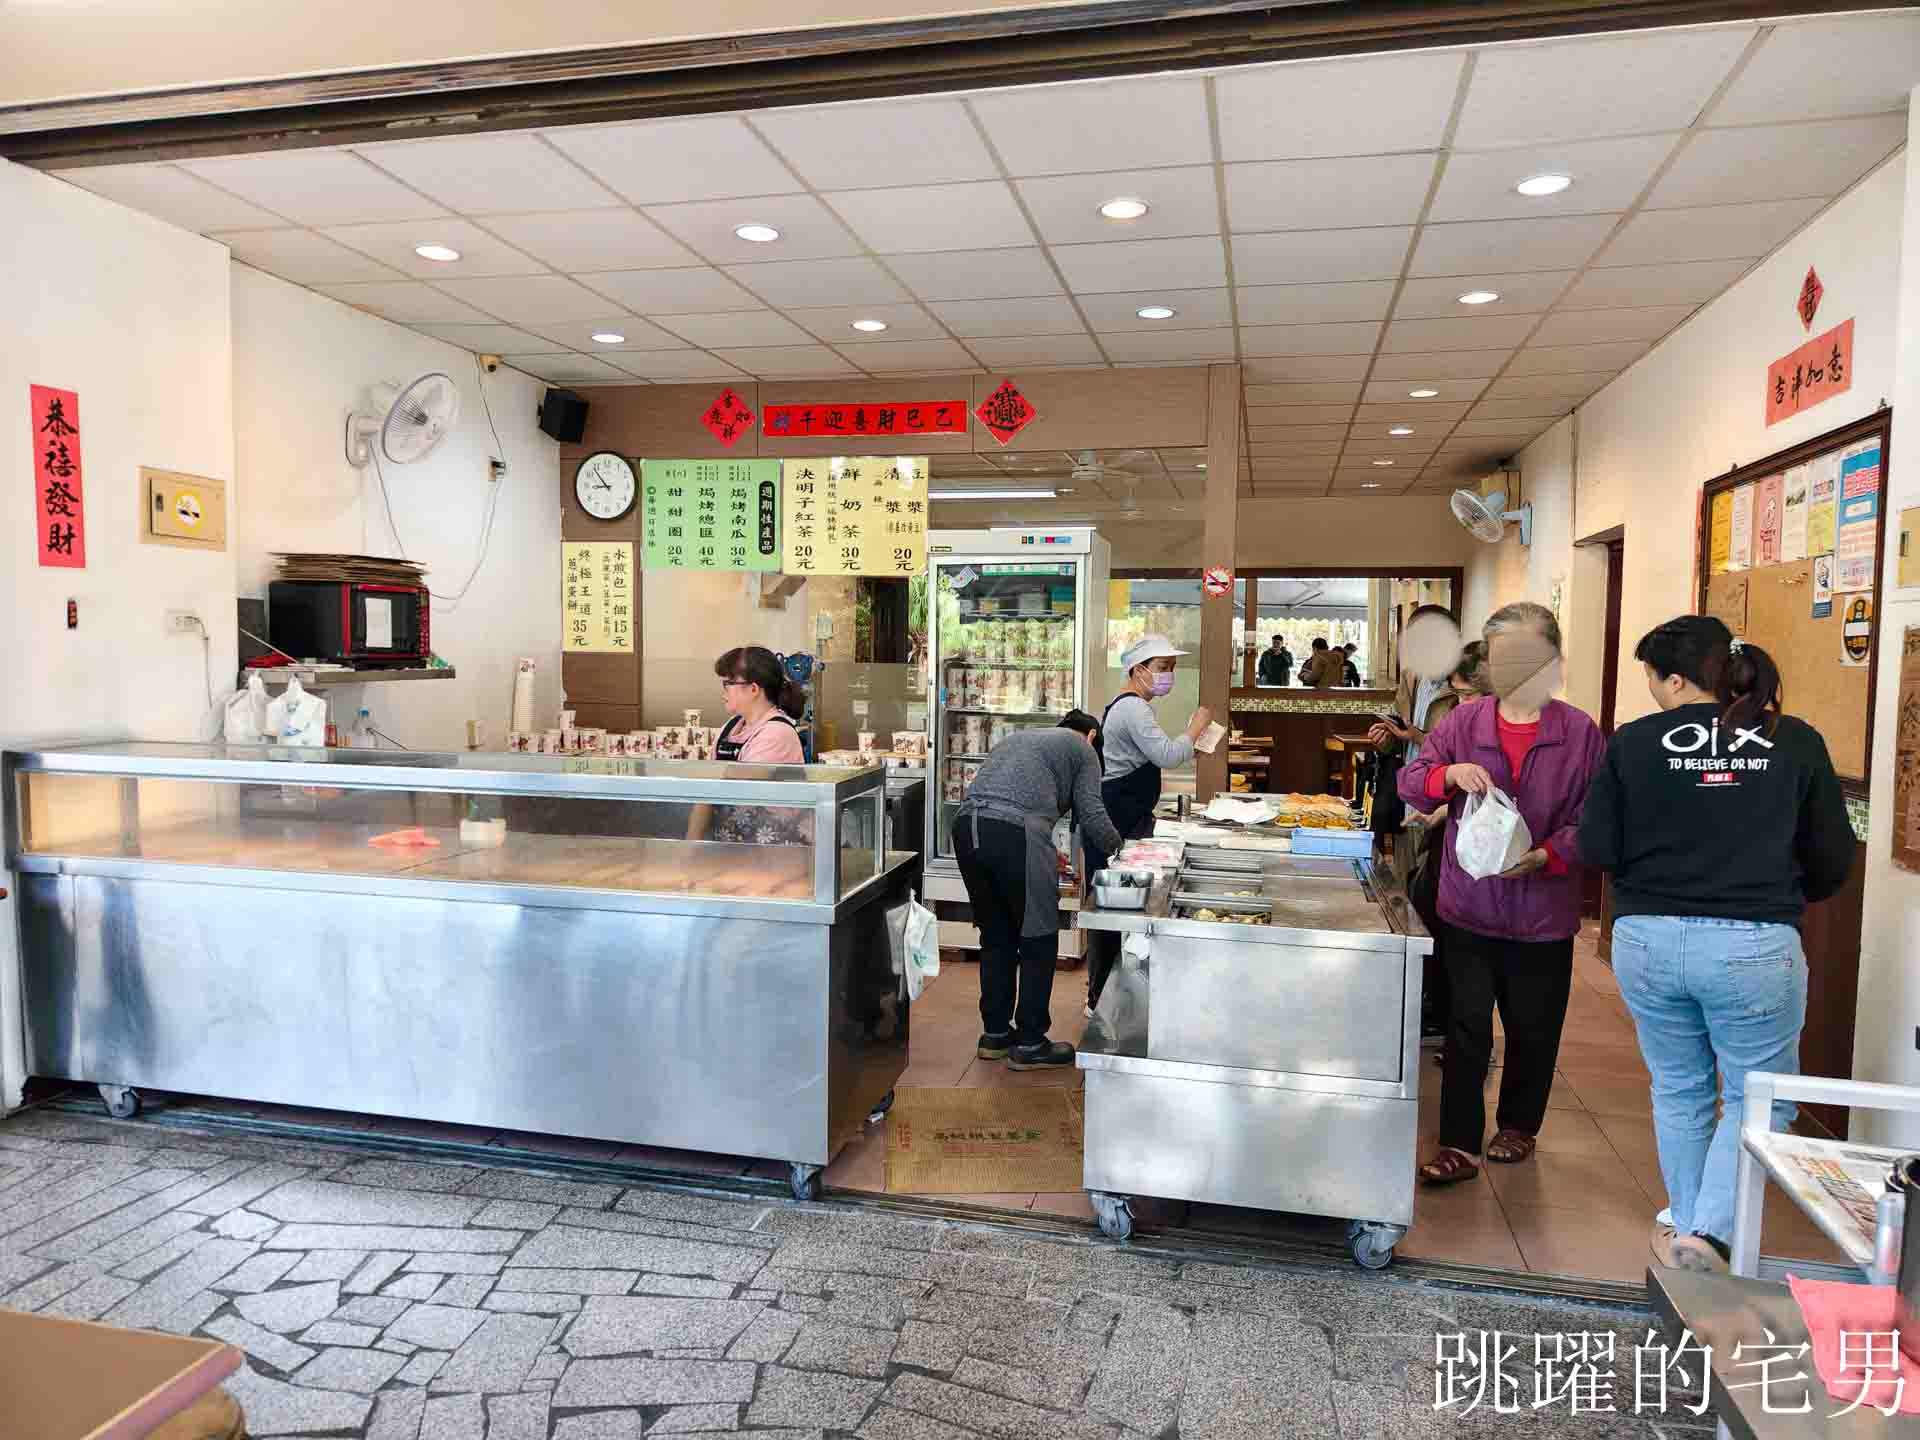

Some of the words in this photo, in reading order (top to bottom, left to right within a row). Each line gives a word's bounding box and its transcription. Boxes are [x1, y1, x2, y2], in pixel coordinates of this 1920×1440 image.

[40, 397, 79, 556] 恭禧發財
[795, 467, 815, 538] 決明子紅茶
[840, 467, 862, 538] 鮮奶茶
[761, 486, 773, 551] 週期性產品
[1668, 758, 1682, 770] TO
[1684, 758, 1729, 770] BELIEVE
[1731, 758, 1746, 770] OR
[1748, 758, 1770, 771] NOT
